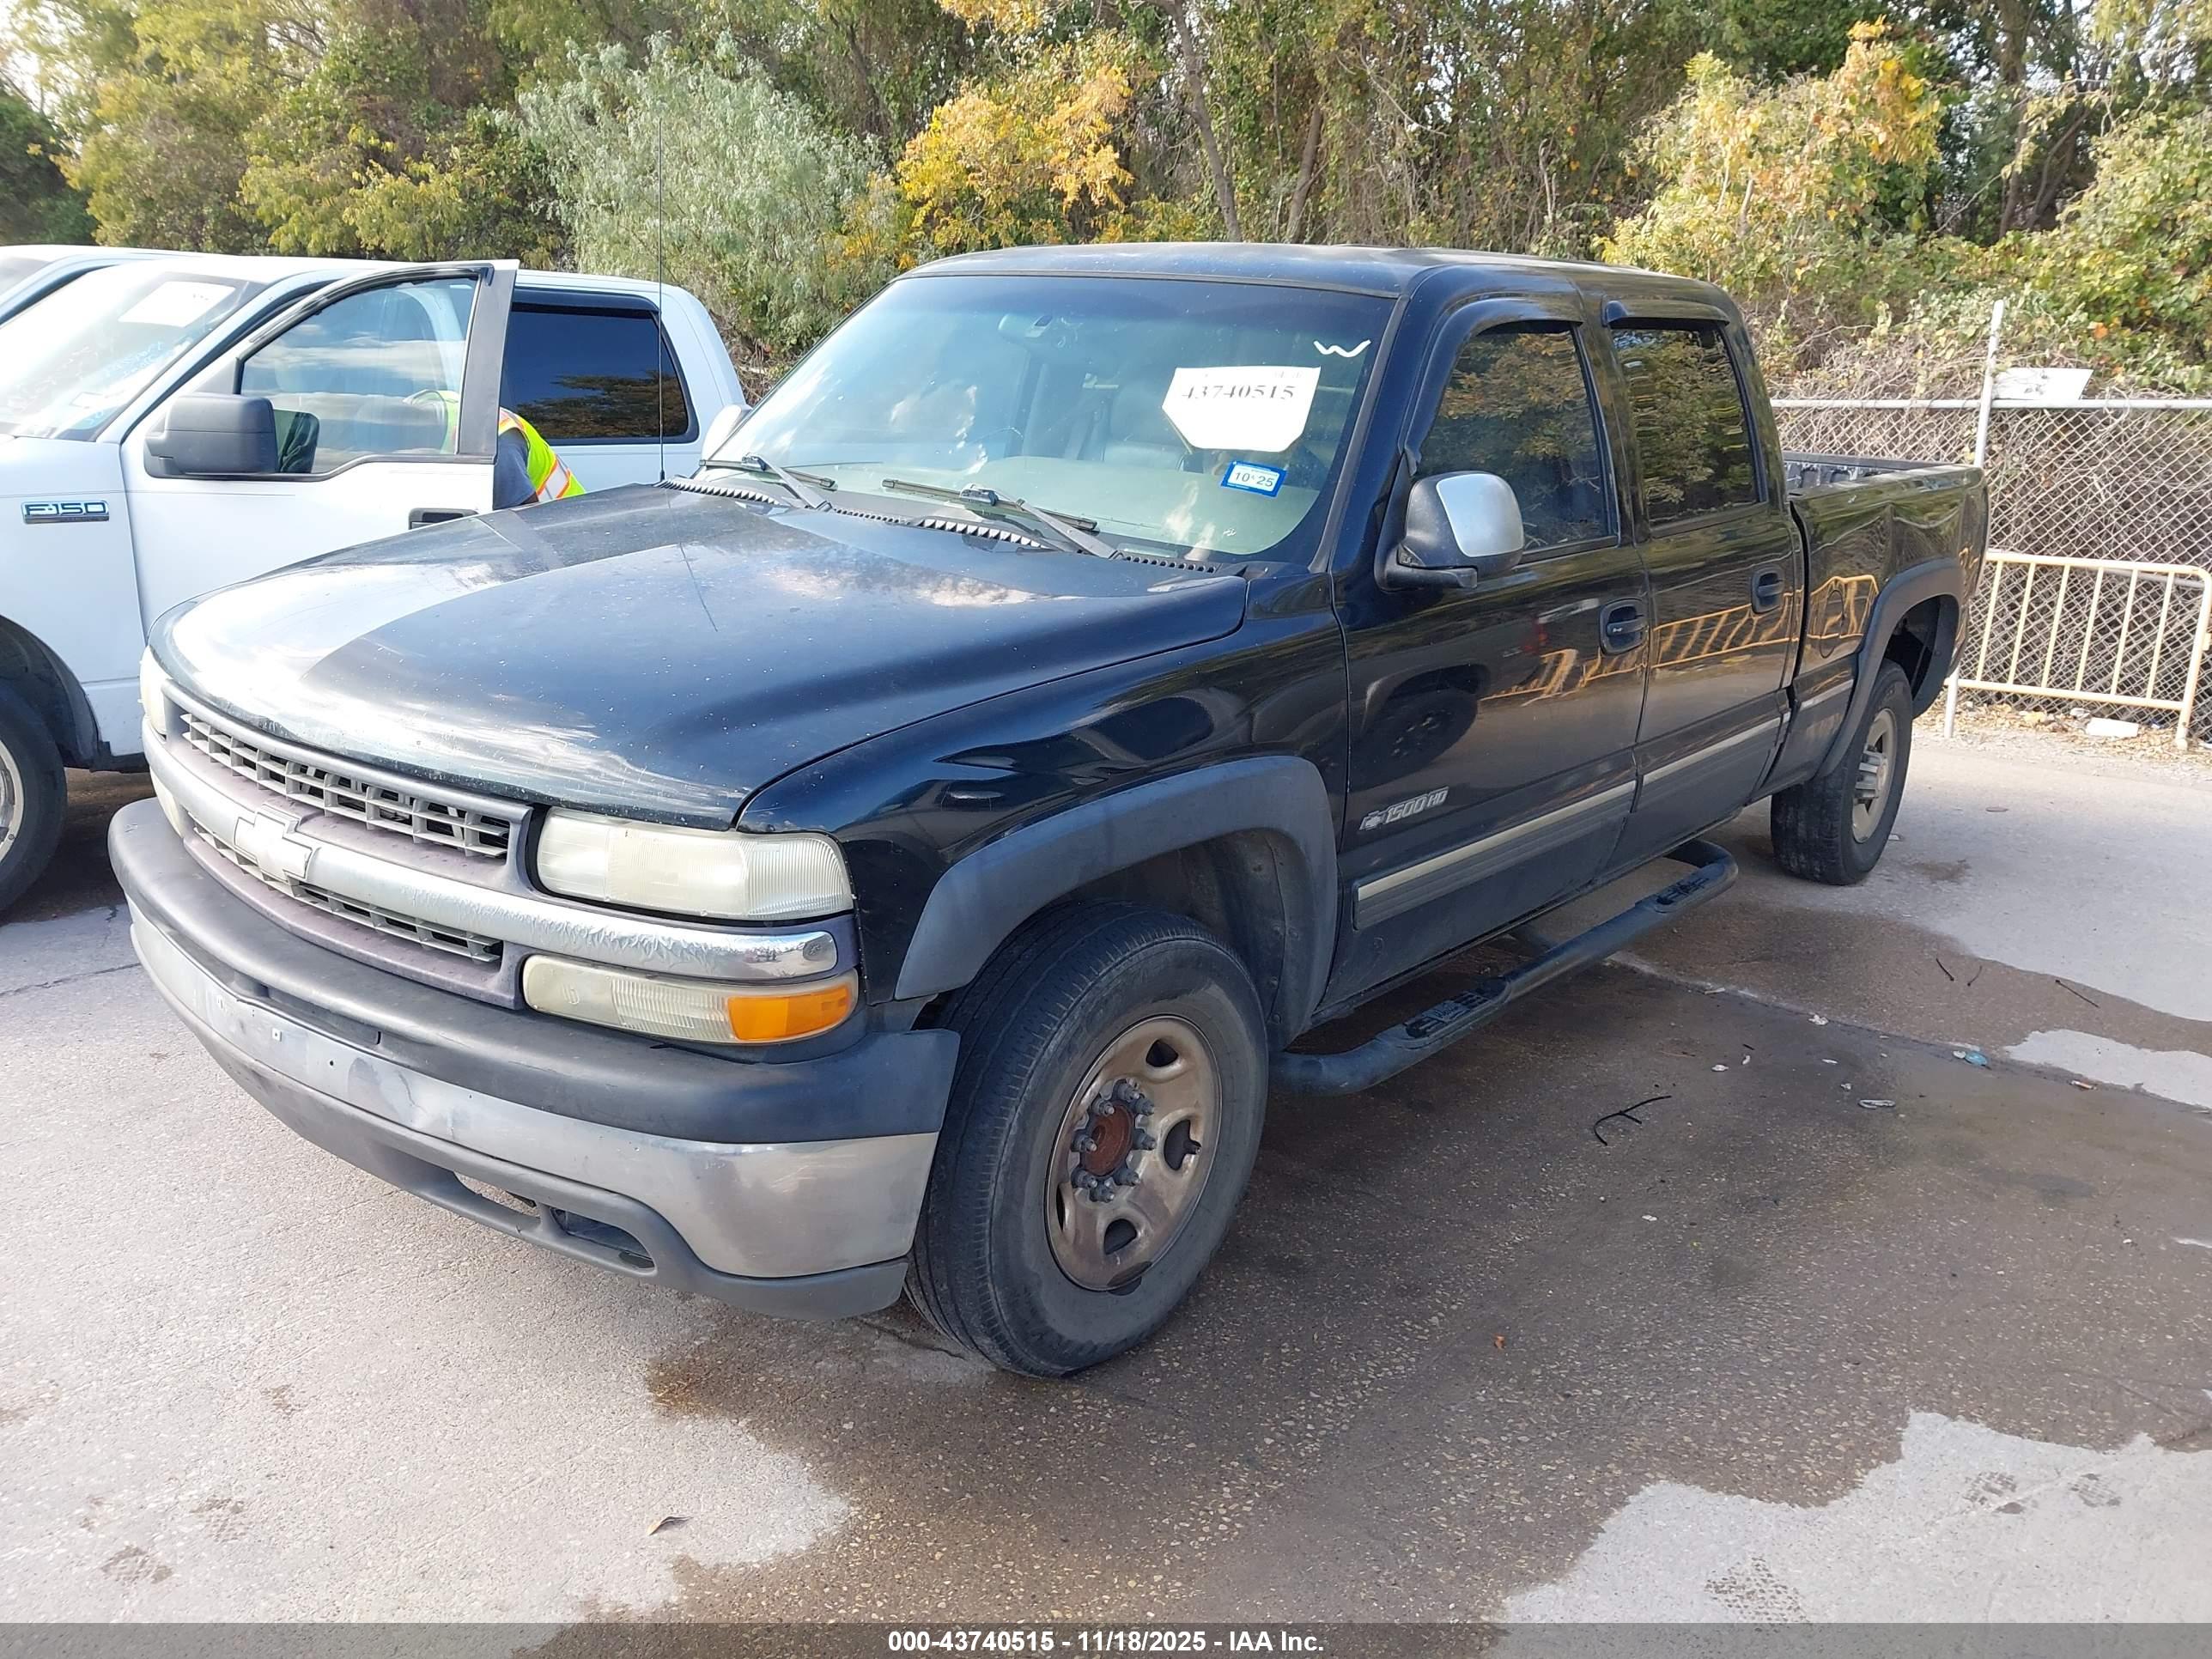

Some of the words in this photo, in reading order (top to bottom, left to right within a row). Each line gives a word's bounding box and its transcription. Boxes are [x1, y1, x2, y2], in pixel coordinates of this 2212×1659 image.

[1182, 385, 1296, 400] 43740515
[24, 501, 106, 516] F-150
[1385, 794, 1427, 823] 1500
[1427, 787, 1449, 807] HD
